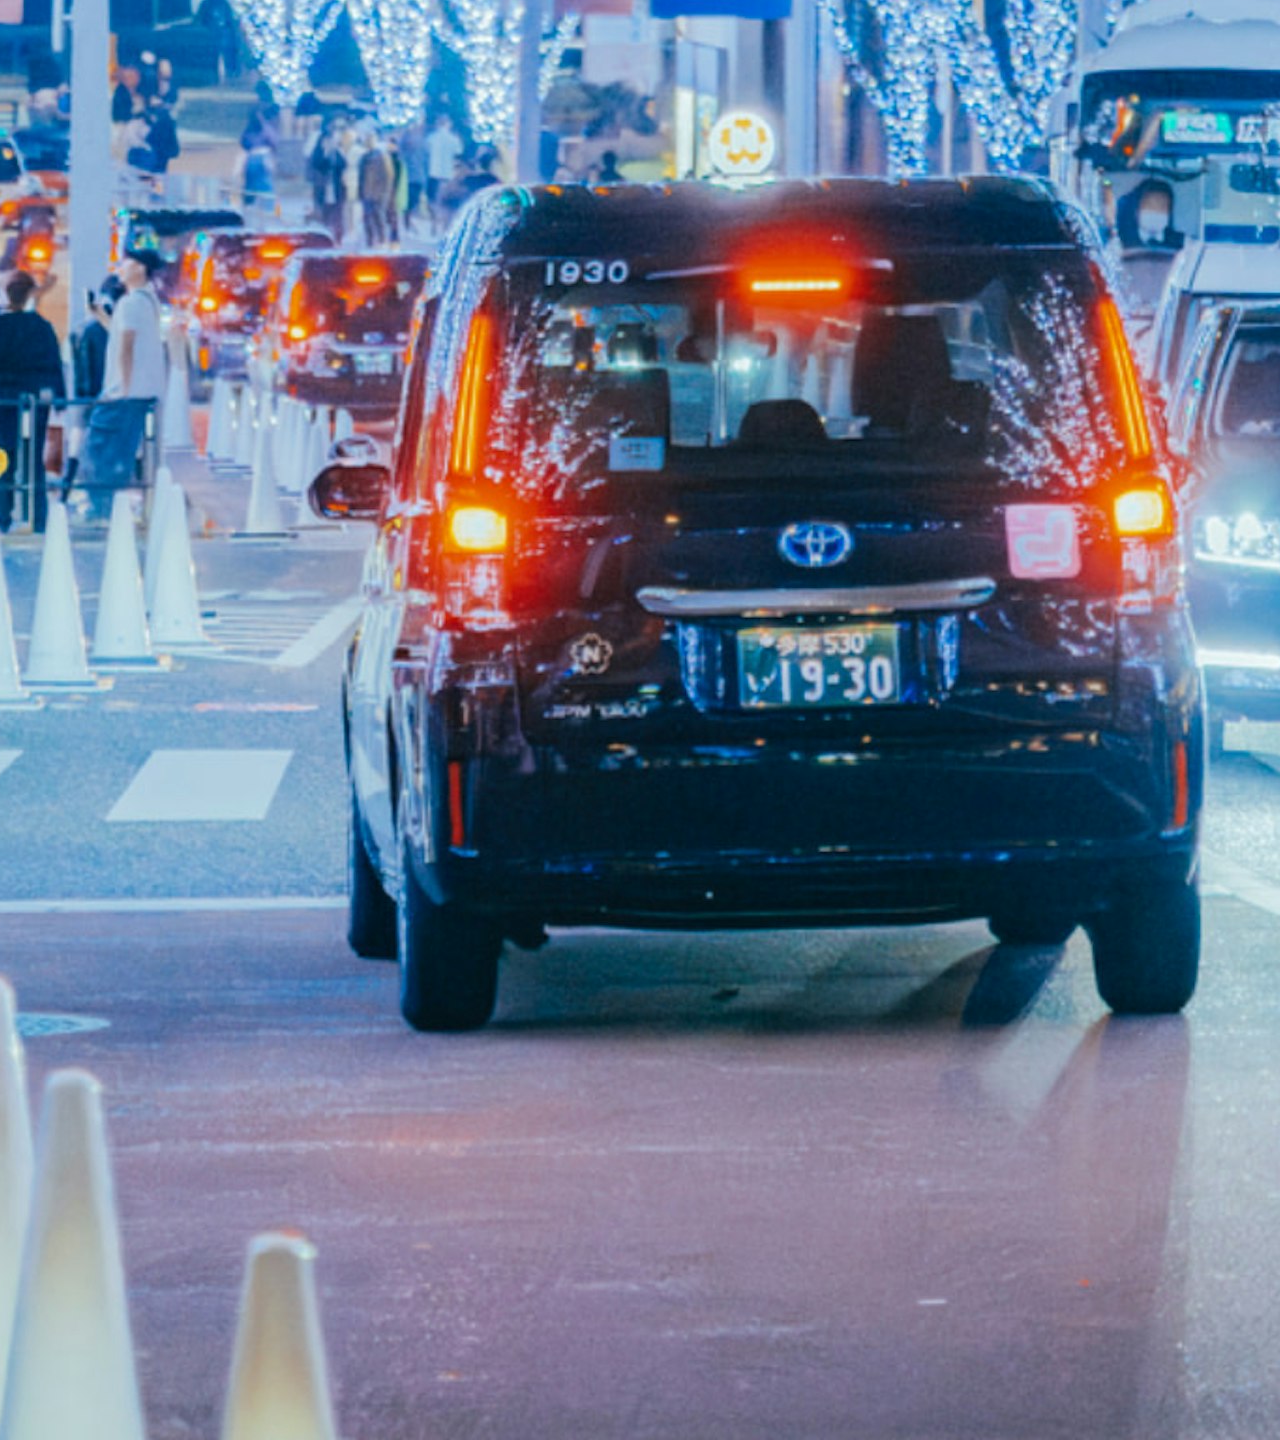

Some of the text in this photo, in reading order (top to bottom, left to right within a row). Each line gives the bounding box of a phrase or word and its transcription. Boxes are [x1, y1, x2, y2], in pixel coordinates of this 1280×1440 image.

[544, 260, 629, 286] 1930
[823, 632, 865, 655] 530
[780, 656, 894, 703] 19-30
